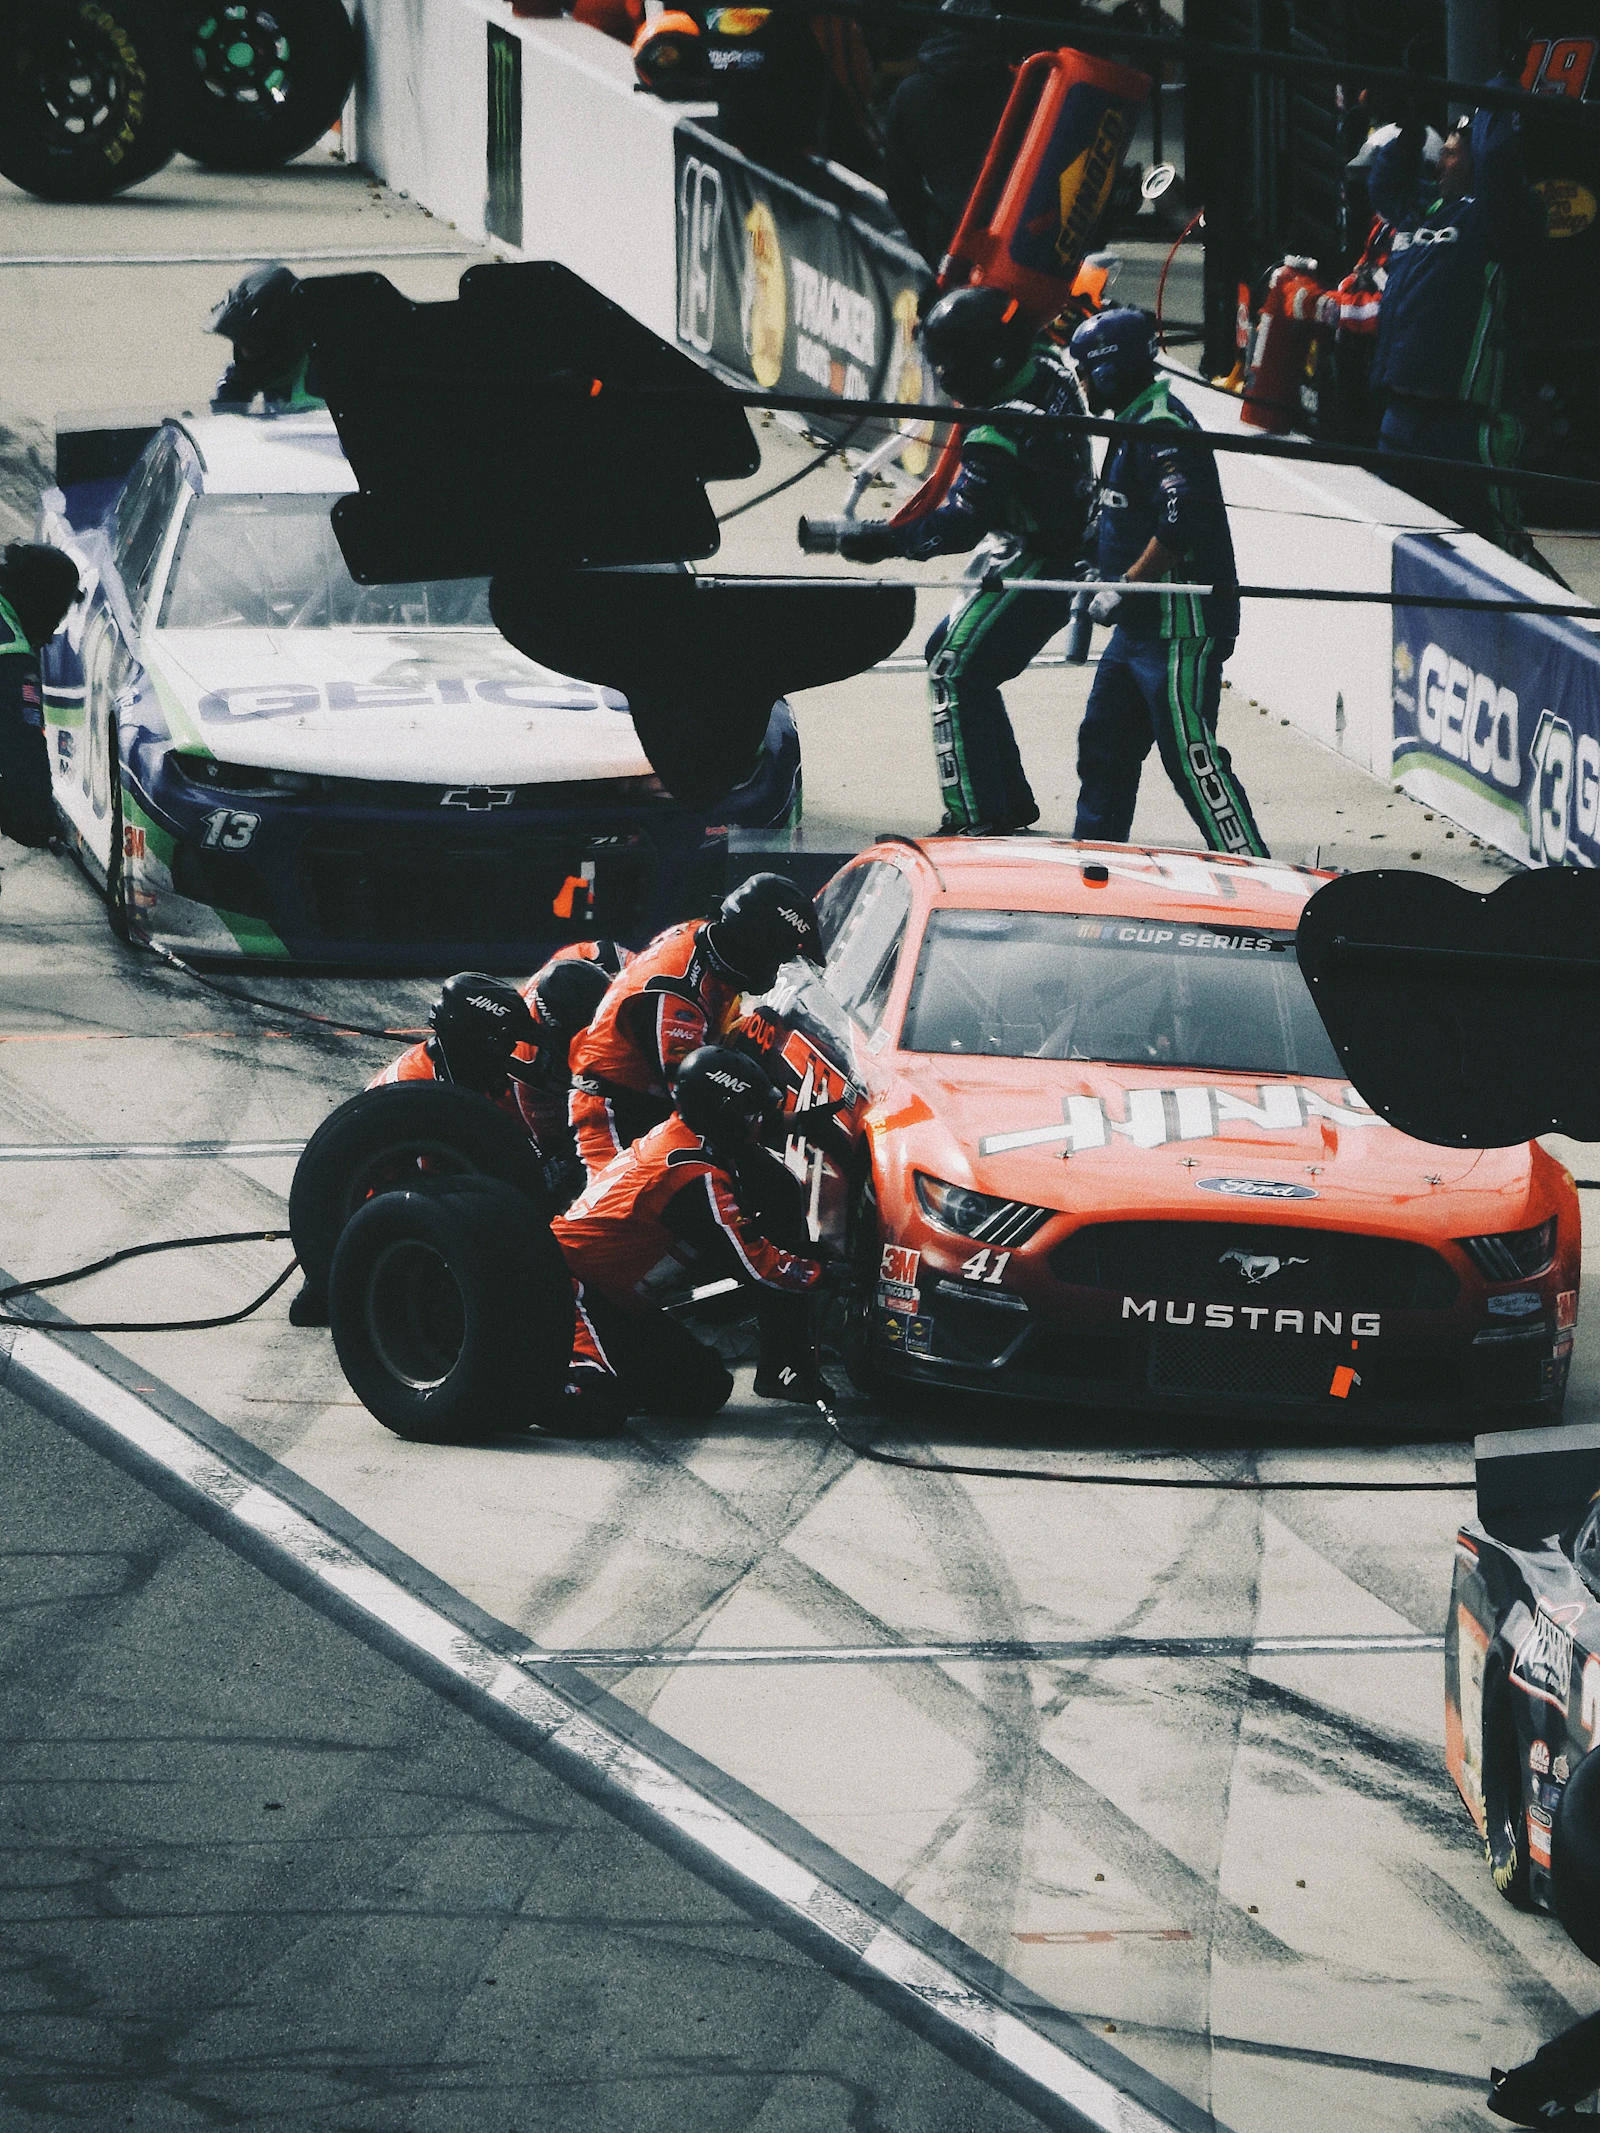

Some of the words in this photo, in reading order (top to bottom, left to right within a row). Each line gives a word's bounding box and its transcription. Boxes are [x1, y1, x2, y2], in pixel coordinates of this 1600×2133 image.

[1519, 38, 1598, 101] 19
[1418, 642, 1521, 788] GEICO
[1529, 708, 1574, 869] 13
[200, 808, 261, 852] 13
[1119, 927, 1175, 944] CUP
[1178, 932, 1274, 952] SERIES
[465, 995, 511, 1018] HAAS
[705, 1069, 751, 1094] HAAS
[1219, 1179, 1294, 1197] Ford
[881, 1247, 917, 1285] 3M
[961, 1248, 1012, 1285] 41
[1121, 1296, 1381, 1337] MUSTANG
[778, 1366, 797, 1386] N
